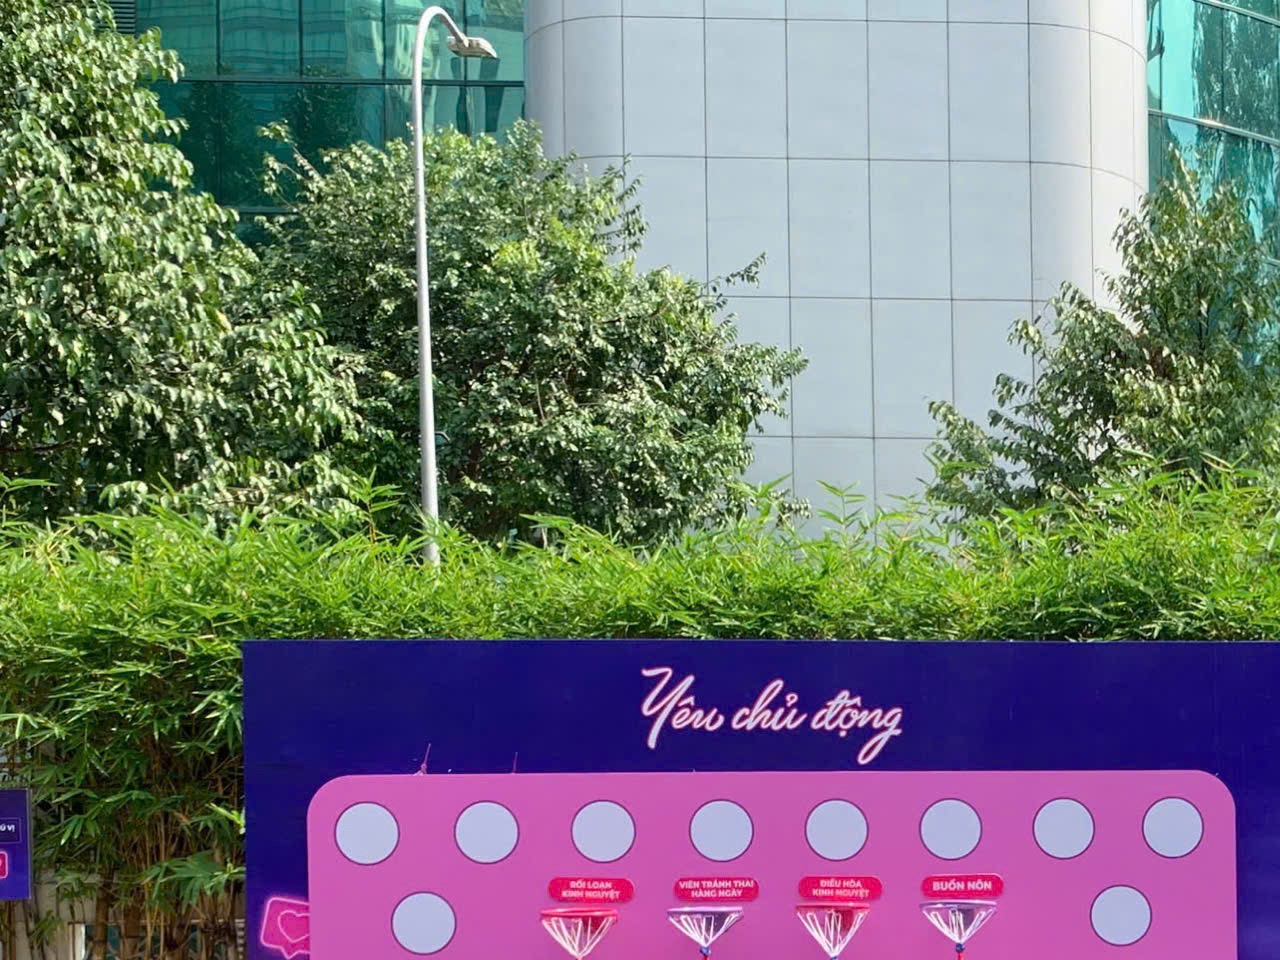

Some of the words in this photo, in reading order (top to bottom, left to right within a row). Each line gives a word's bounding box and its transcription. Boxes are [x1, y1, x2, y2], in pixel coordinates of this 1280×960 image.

[641, 667, 724, 749] Yêu
[731, 679, 807, 731] chủ
[810, 690, 903, 765] động
[733, 879, 754, 888] THAI
[967, 877, 992, 891] NÔN
